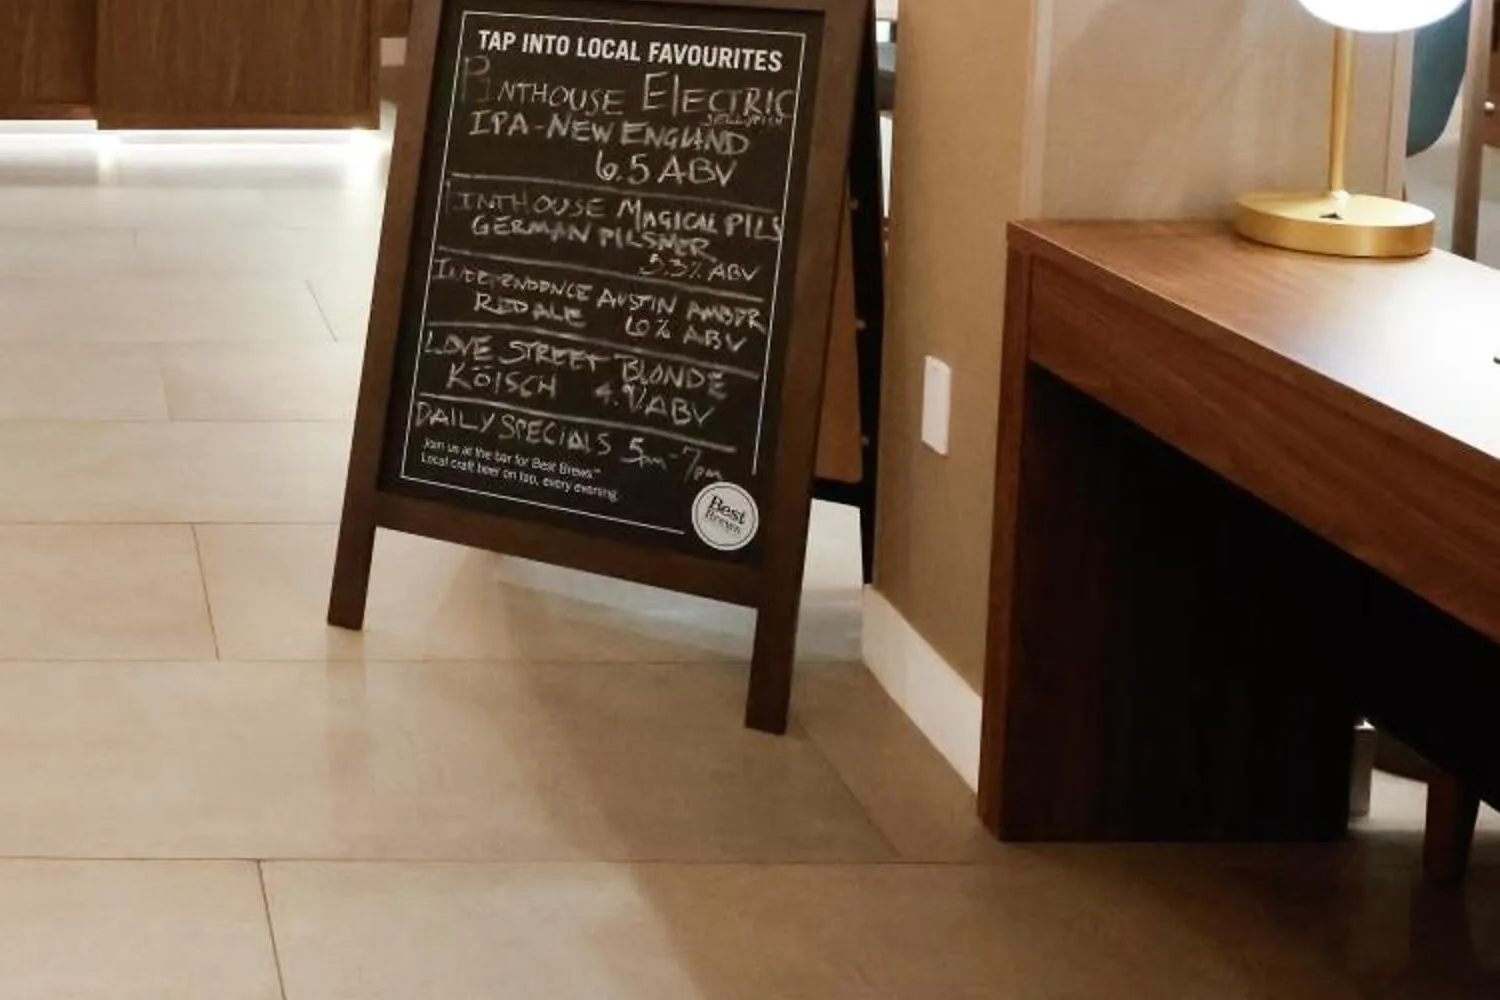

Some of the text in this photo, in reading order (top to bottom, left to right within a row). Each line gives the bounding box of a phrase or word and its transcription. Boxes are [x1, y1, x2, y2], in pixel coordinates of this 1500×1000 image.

[478, 30, 783, 72] TAP INTO LOCAL FAVOURITES
[620, 120, 750, 156] ENGLAND
[595, 149, 738, 187] 6.5 ABV
[471, 215, 592, 243] GERMAN
[617, 198, 718, 234] MAGICAL
[707, 263, 761, 281] ABV
[596, 288, 677, 315] AUSTIN
[474, 292, 529, 316] RED
[533, 302, 587, 328] ALE
[682, 325, 748, 352] ABV
[424, 330, 493, 361] LOVE
[613, 354, 728, 400] BLONDE
[414, 401, 496, 433] DAILY
[421, 451, 449, 467] Local
[542, 477, 571, 493] every
[709, 495, 746, 525] Best
